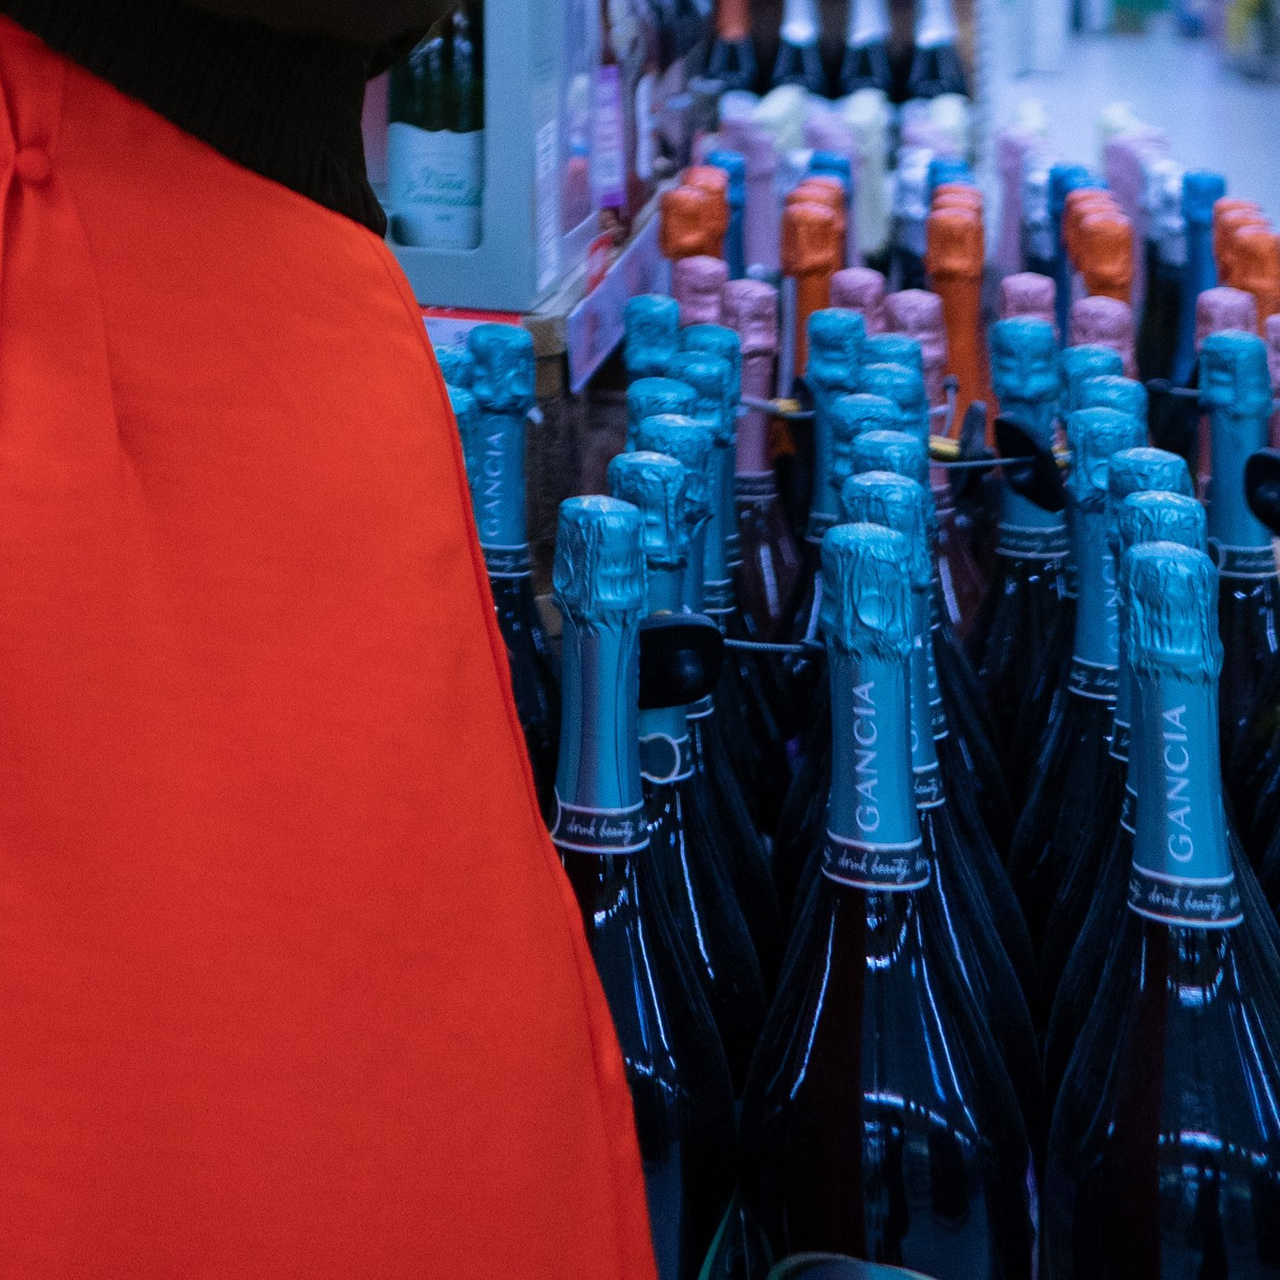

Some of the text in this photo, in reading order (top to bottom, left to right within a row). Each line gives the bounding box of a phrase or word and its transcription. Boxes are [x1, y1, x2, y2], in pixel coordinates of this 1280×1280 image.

[481, 432, 504, 537] GANCIA
[852, 680, 880, 832] GANCIA
[1162, 703, 1194, 863] GANCIA
[567, 816, 595, 838] drink
[599, 818, 635, 846] beauty
[838, 848, 868, 875] drink
[871, 853, 910, 884] beauty
[1148, 883, 1179, 909] drink
[1184, 891, 1226, 920] beauty
